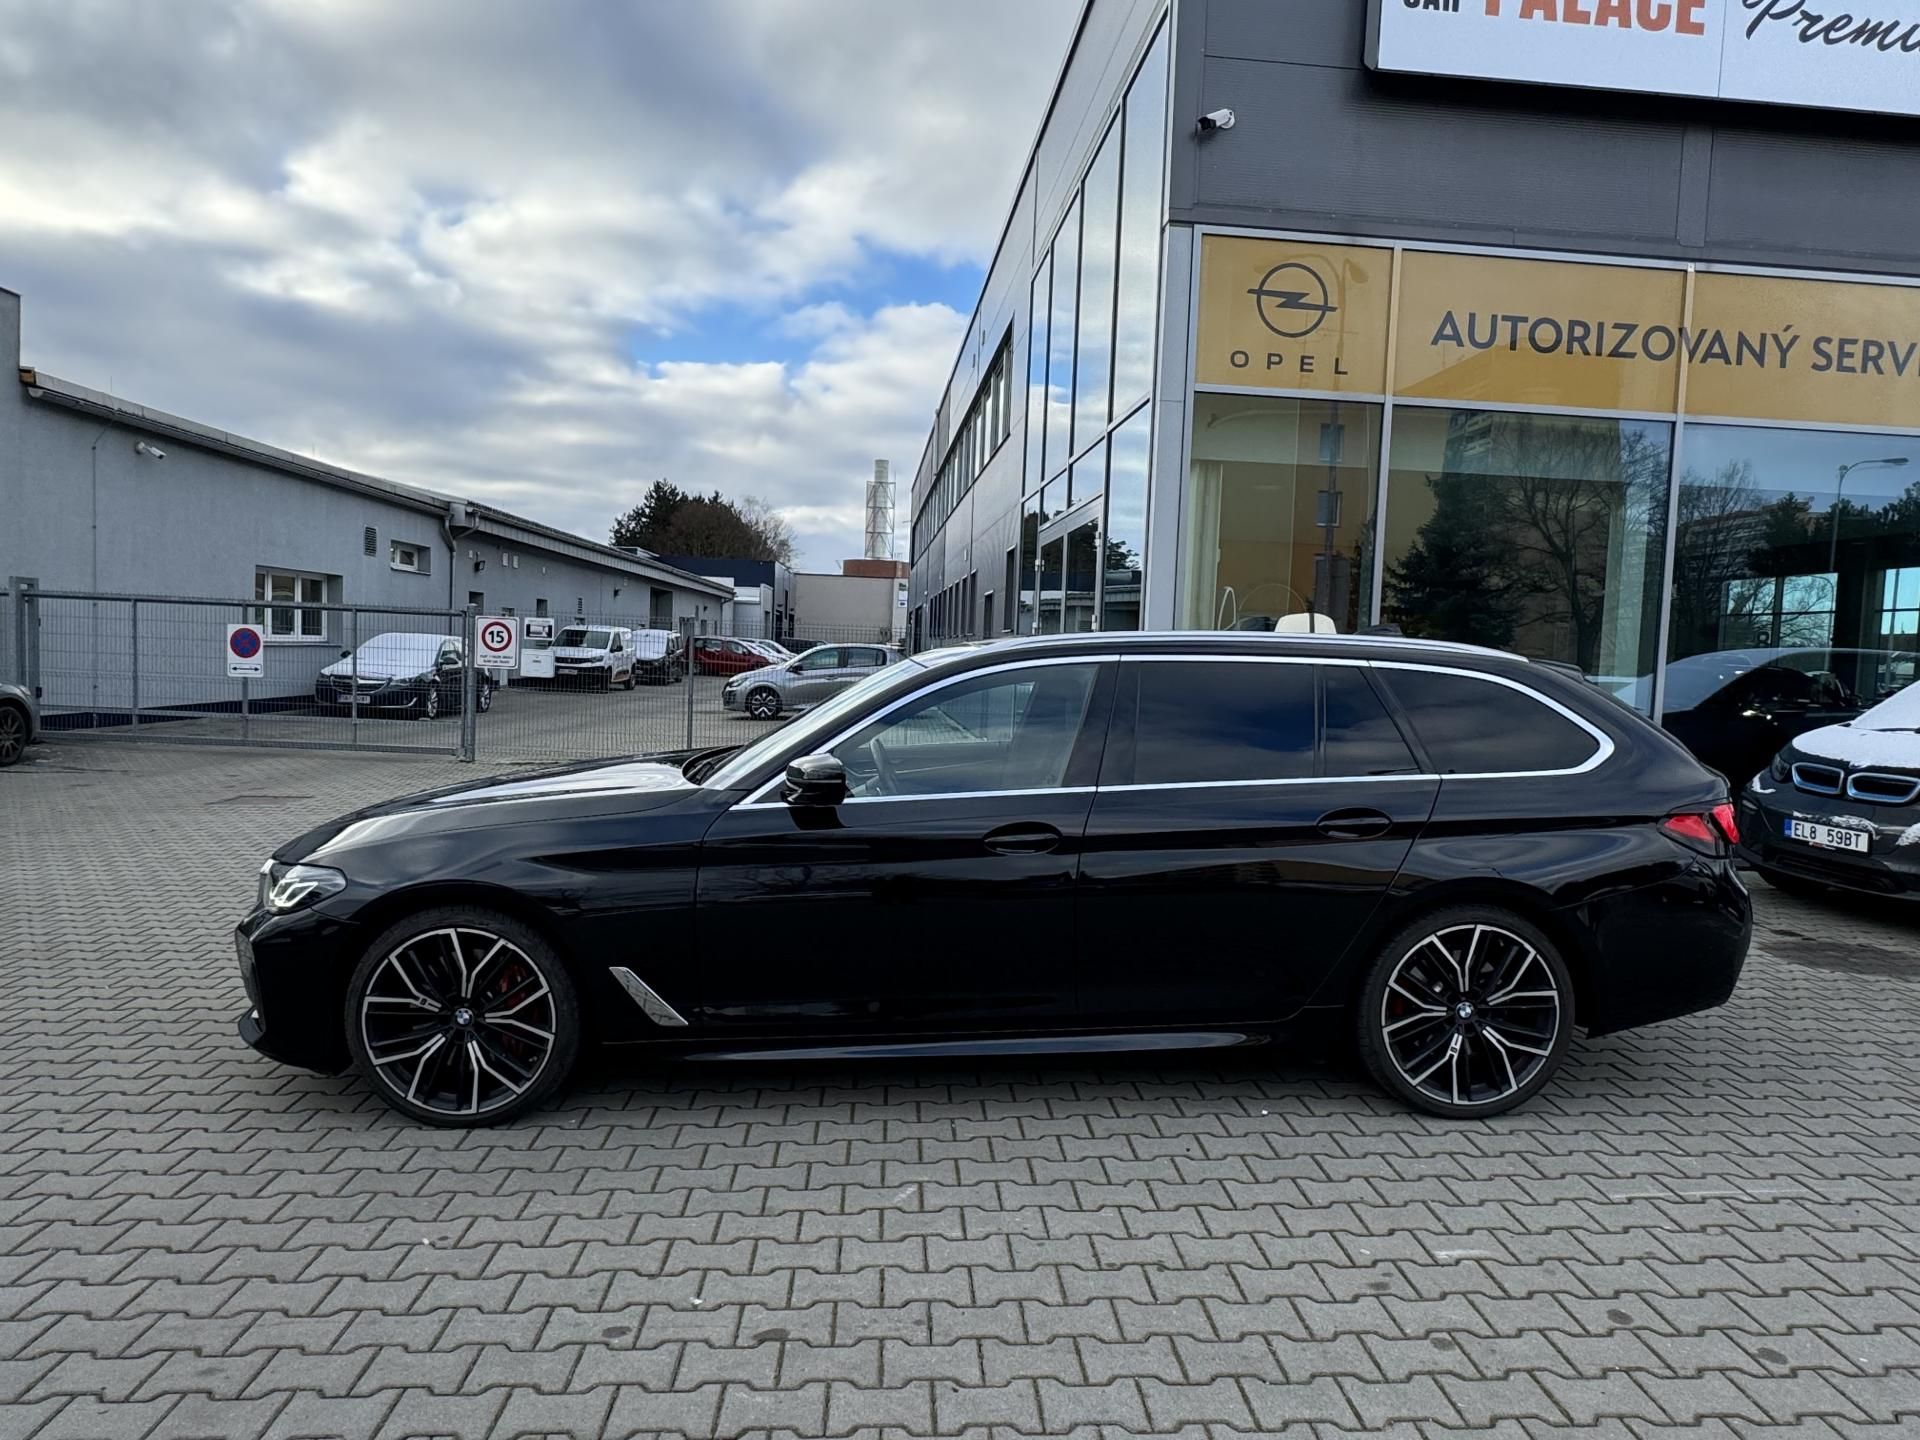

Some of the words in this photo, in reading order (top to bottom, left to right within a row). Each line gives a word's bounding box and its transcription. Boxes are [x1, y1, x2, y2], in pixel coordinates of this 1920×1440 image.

[1485, 0, 1705, 35] LACE
[1431, 311, 1800, 368] AUTORIZOVANÝ
[1230, 350, 1348, 375] OPEL
[488, 630, 504, 643] 15
[1794, 822, 1817, 840] EL8
[1826, 828, 1861, 848] 59BT
